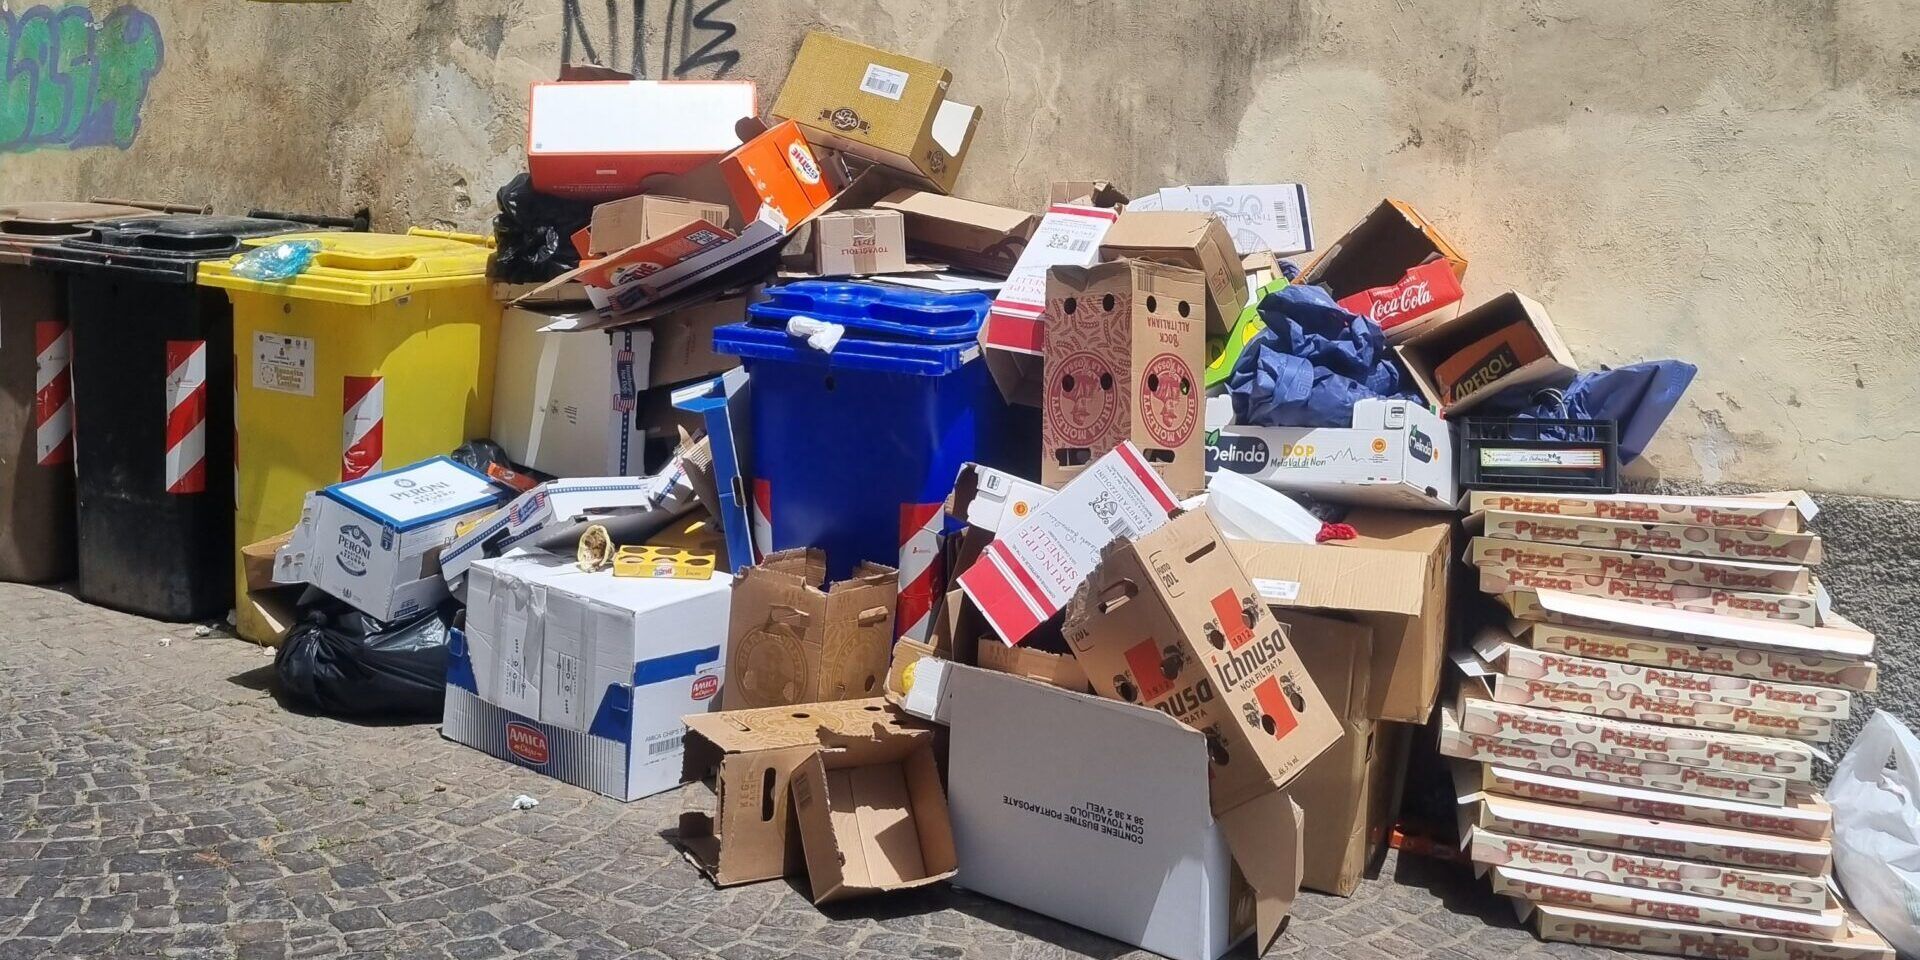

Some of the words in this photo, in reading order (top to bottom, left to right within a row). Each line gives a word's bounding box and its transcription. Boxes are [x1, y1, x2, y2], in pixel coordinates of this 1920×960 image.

[1146, 316, 1189, 333] ALL'ITALIANA
[1158, 332, 1178, 347] BOCK
[1456, 354, 1512, 400] APEROL
[1051, 396, 1086, 440] MORETTI
[1088, 392, 1112, 436] BIRRA
[1143, 394, 1174, 442] MORETTI
[1174, 397, 1194, 438] BIRRA
[1206, 444, 1265, 462] Melinda
[1283, 444, 1315, 457] DOP
[1409, 436, 1432, 456] Melinda
[1310, 456, 1326, 466] Non
[390, 482, 451, 501] PERONI
[1500, 497, 1560, 514] Pizza
[1594, 502, 1659, 520] Pizza
[1696, 508, 1763, 526] Pizza
[338, 535, 371, 560] PERONI
[1515, 521, 1579, 540] Pizza
[1615, 530, 1681, 549] Pizza
[1719, 538, 1788, 557] Pizza
[1018, 529, 1072, 592] PRINCIPE
[1501, 548, 1564, 568] Pizza
[1601, 557, 1666, 578] Pizza
[1704, 567, 1772, 587] Pizza
[1162, 574, 1179, 588] 20L
[1508, 570, 1572, 590] Pizza
[1608, 580, 1674, 601] Pizza
[1712, 591, 1780, 614] Pizza
[1232, 629, 1252, 645] 1912
[1564, 636, 1629, 658] Pizza
[1667, 650, 1734, 671] Pizza
[1772, 662, 1841, 684] Pizza
[693, 679, 717, 693] AMICA
[1240, 678, 1256, 693] NON
[1255, 659, 1284, 682] FILTRATA
[1542, 656, 1607, 678] Pizza
[1646, 669, 1711, 692] Pizza
[1750, 683, 1817, 705] Pizza
[1158, 678, 1215, 717] nusa
[1528, 680, 1592, 703] Pizza
[1630, 693, 1695, 716] Pizza
[1733, 707, 1800, 730] Pizza
[1180, 710, 1208, 724] TRATA
[510, 728, 546, 750] AMICA
[1497, 713, 1562, 736] Pizza
[1601, 727, 1667, 752] Pizza
[1707, 744, 1776, 766] Pizza
[1472, 737, 1537, 760] Pizza
[1576, 752, 1642, 776] Pizza
[1681, 769, 1750, 791] Pizza
[1003, 796, 1062, 819] PORTAPOSATE
[1070, 806, 1123, 829] TOVAGLIOLO
[1086, 802, 1105, 815] VELI
[1108, 808, 1113, 816] 2
[1115, 810, 1125, 819] 38
[1064, 814, 1099, 831] BUSTINE
[1126, 822, 1144, 835] CON
[1134, 816, 1144, 825] 38
[1724, 810, 1794, 831] Pizza
[1100, 824, 1144, 845] CONTIENE
[1507, 842, 1573, 866] Pizza
[1612, 855, 1680, 880] Pizza
[1721, 872, 1792, 896] Pizza
[1525, 882, 1592, 903] Pizza
[1632, 898, 1700, 918] Pizza
[1574, 923, 1641, 945] Pizza
[1680, 935, 1749, 958] Pizza
